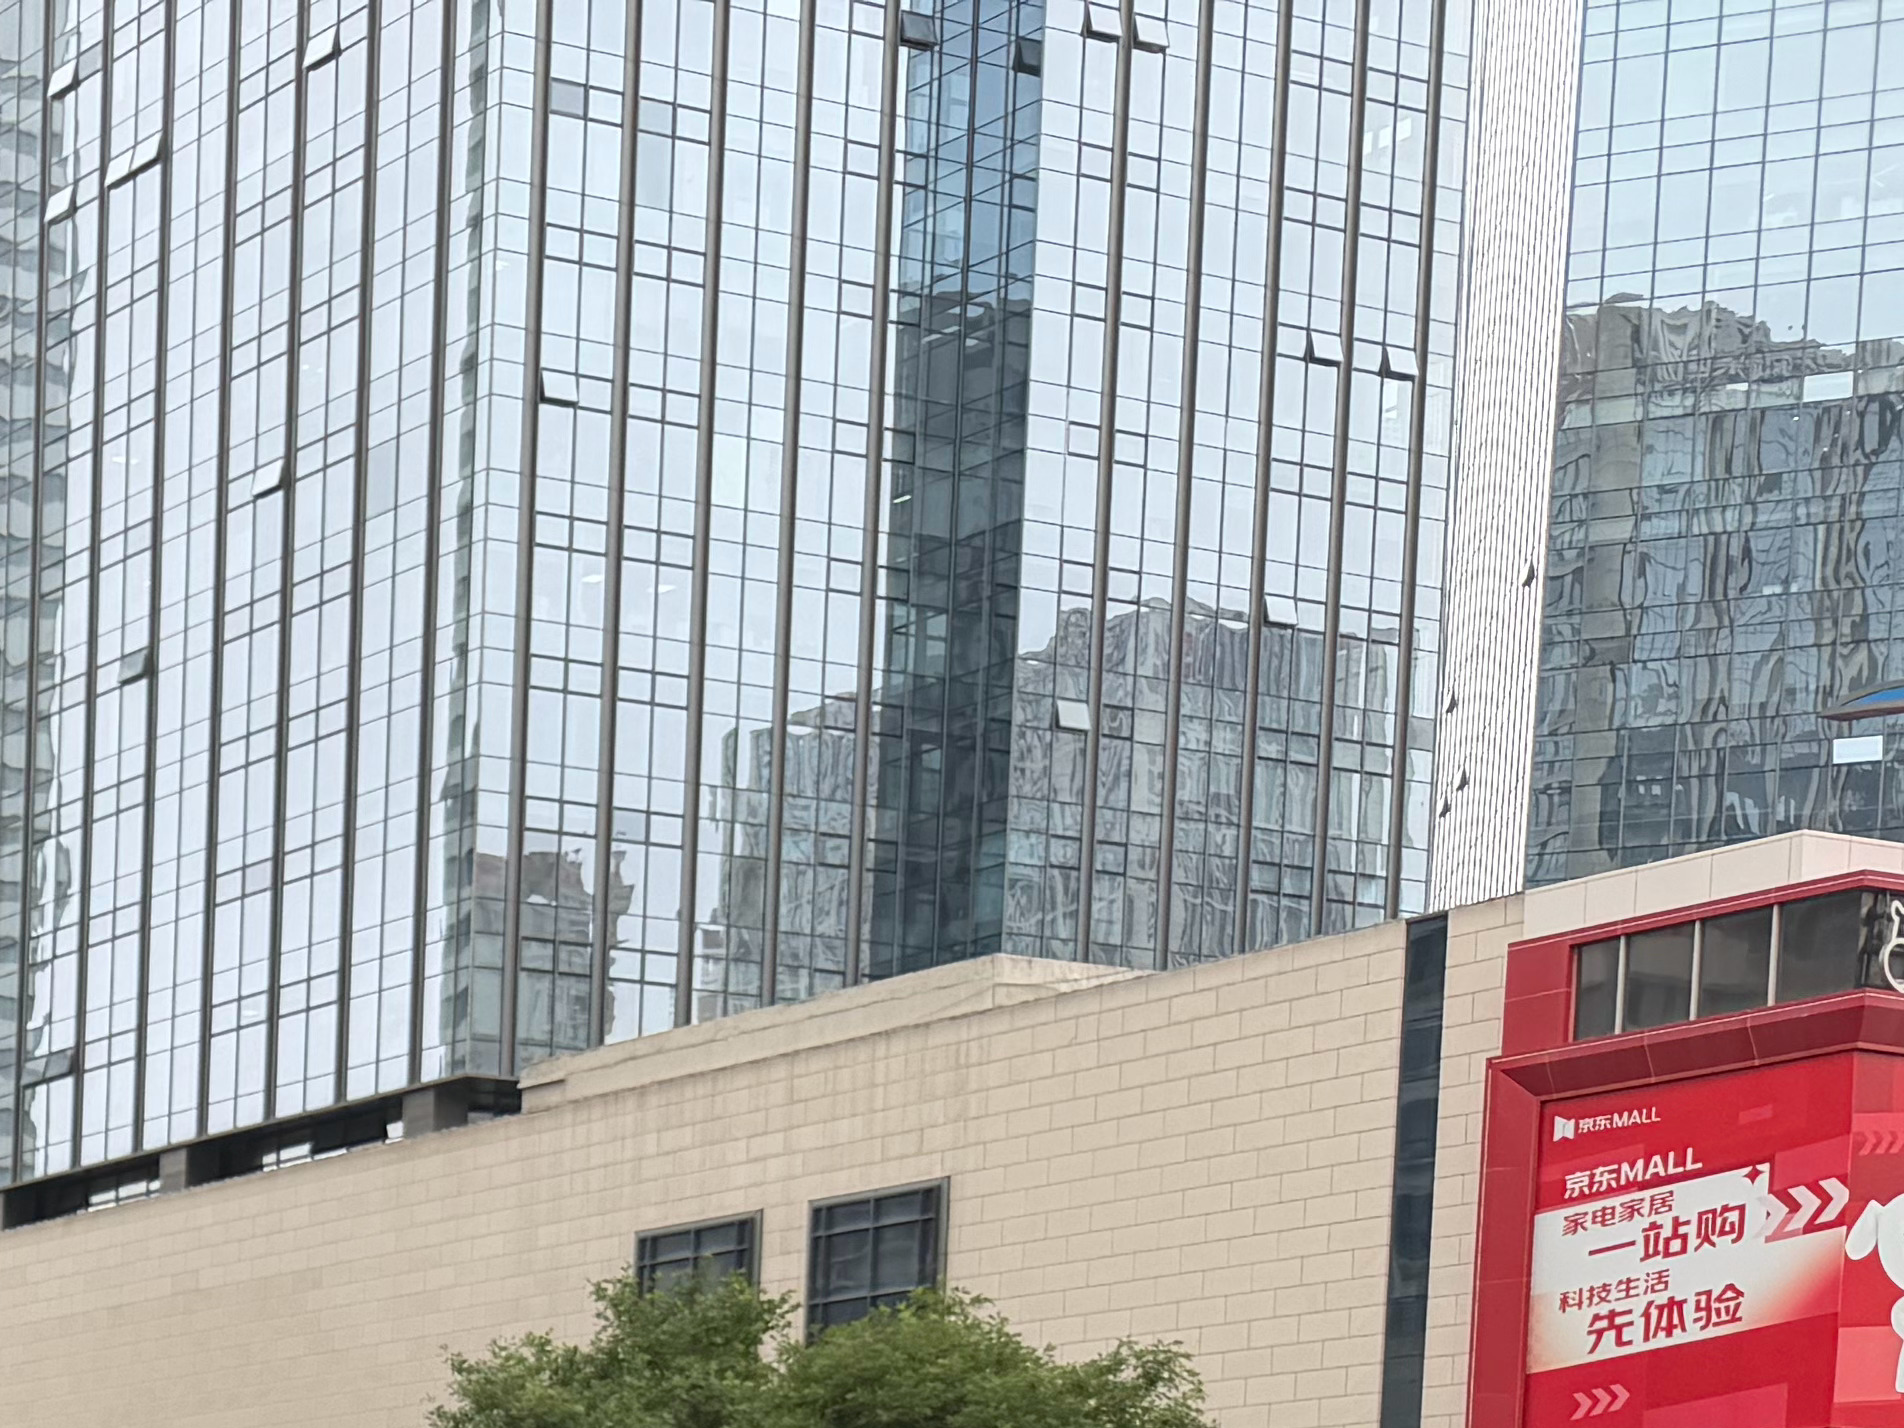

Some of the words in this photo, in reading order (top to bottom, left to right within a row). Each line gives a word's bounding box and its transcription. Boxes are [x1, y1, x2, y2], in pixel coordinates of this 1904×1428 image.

[1578, 1106, 1661, 1134] 京东MALL
[1563, 1147, 1703, 1200] 京东MALL
[1562, 1190, 1675, 1237] 家电家居
[1588, 1203, 1746, 1263] 一站购
[1558, 1268, 1671, 1314] 科技生活
[1586, 1282, 1746, 1354] 先体验
